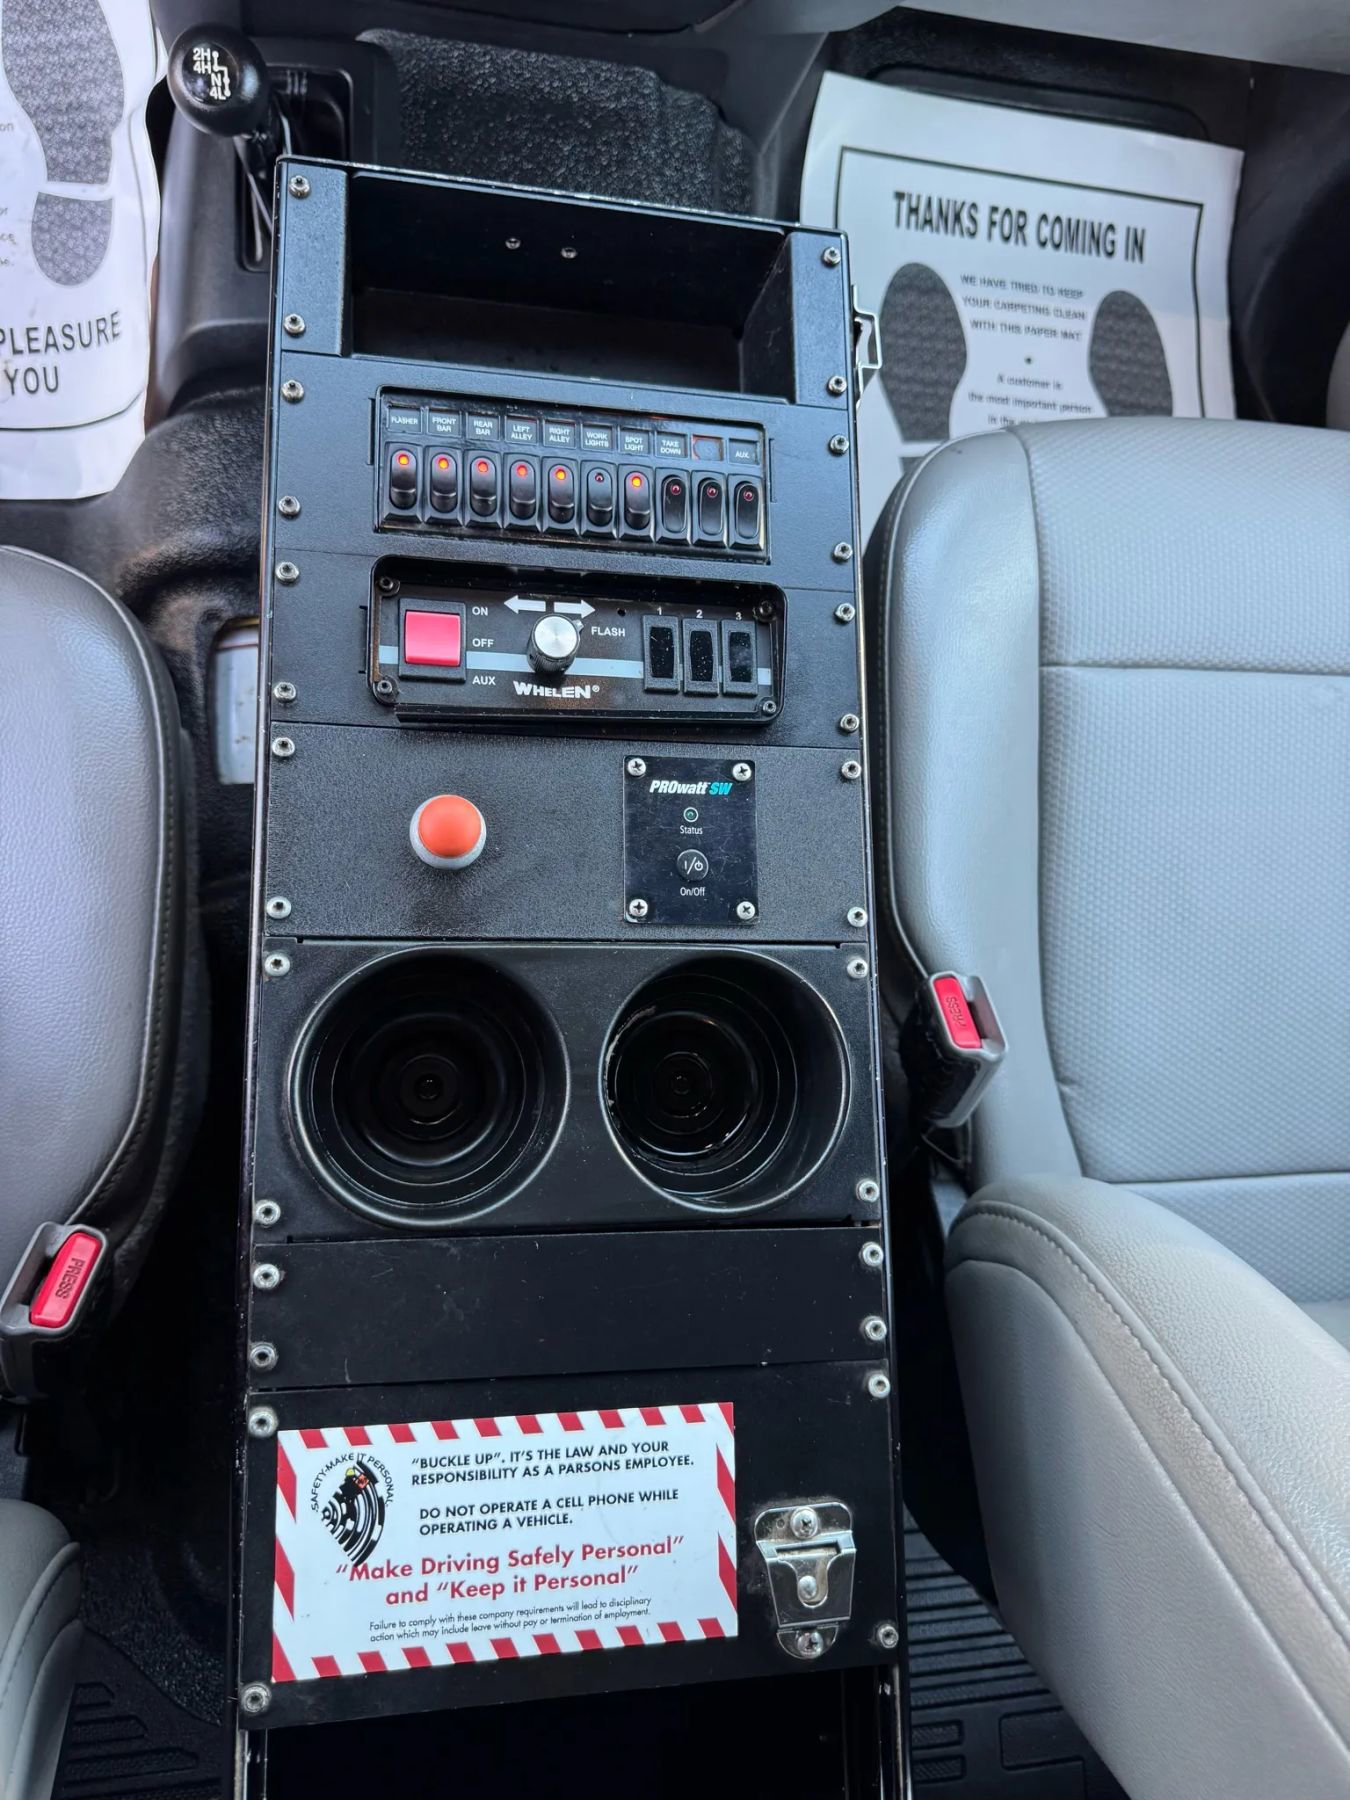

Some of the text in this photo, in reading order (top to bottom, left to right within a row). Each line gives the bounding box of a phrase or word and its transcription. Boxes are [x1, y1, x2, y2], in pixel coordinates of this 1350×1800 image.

[193, 47, 211, 60] 2H
[193, 61, 211, 74] 4H
[211, 72, 222, 86] N
[209, 86, 227, 100] 4L
[893, 191, 1147, 264] THANKS FOR COMING IN
[960, 274, 1084, 299] WE HAVE TRIED TO KEEP
[962, 296, 1086, 320] YOUR CARPETING CLEAN
[970, 320, 1082, 342] WITH THIS PAPER MAT
[4, 365, 59, 396] YOU
[1007, 376, 1051, 389] customer
[968, 391, 1092, 415] the most important person
[391, 417, 419, 425] FLASHER
[432, 416, 457, 425] FRONT
[473, 420, 493, 428] REAR
[437, 424, 452, 432] BAR
[475, 428, 491, 436] BAR
[512, 425, 530, 433] LEFT
[550, 427, 570, 436] RIGHT
[511, 432, 532, 441] ALLEY
[550, 435, 570, 443] ALLEY
[586, 431, 608, 440] WORK
[625, 436, 643, 445] SPOT
[585, 439, 609, 448] LIGHTS
[624, 443, 644, 451] LIGHT
[662, 440, 679, 448] TAKE
[660, 446, 681, 455] DOWN
[472, 606, 488, 616] ON
[656, 606, 662, 616] 1
[696, 609, 703, 619] 2
[735, 611, 742, 620] 3
[591, 626, 626, 637] FLASH
[472, 638, 494, 647] OFF
[472, 675, 496, 686] AUX
[649, 780, 733, 796] PROwatt SW
[680, 825, 703, 835] Status
[680, 887, 705, 897] On/Off
[55, 1257, 85, 1299] PRESS
[510, 1450, 533, 1462] IT'S
[537, 1448, 560, 1460] THE
[565, 1446, 594, 1458] LAW
[598, 1444, 628, 1456] AND
[631, 1441, 669, 1454] YOUR
[356, 1453, 366, 1461] IT
[412, 1455, 694, 1486] RESPONSIBILITY AS A PARSONS EMPLOYEE.
[420, 1489, 679, 1519] DO NOT OPERATE A CELL PHONE WHILE
[420, 1513, 573, 1536] OPERATING A VEHICLE.
[421, 1552, 499, 1574] Driving
[508, 1544, 574, 1568] Safely
[386, 1582, 429, 1605] and
[513, 1575, 527, 1593] it
[369, 1620, 397, 1631] Failure
[408, 1614, 437, 1627] comply
[438, 1613, 455, 1623] with
[457, 1611, 477, 1622] these
[479, 1610, 514, 1622] company
[516, 1606, 564, 1618] requirements
[566, 1600, 579, 1611] will
[581, 1599, 598, 1610] lead
[600, 1600, 607, 1608] to
[609, 1596, 652, 1608] disciplinary
[370, 1632, 394, 1642] action
[396, 1630, 420, 1640] which
[422, 1628, 439, 1638] may
[441, 1624, 469, 1635] include
[471, 1621, 492, 1632] leave
[494, 1618, 521, 1629] without
[523, 1619, 537, 1629] pay
[550, 1612, 593, 1624] termination
[594, 1610, 603, 1620] of
[604, 1608, 651, 1620] employment.
